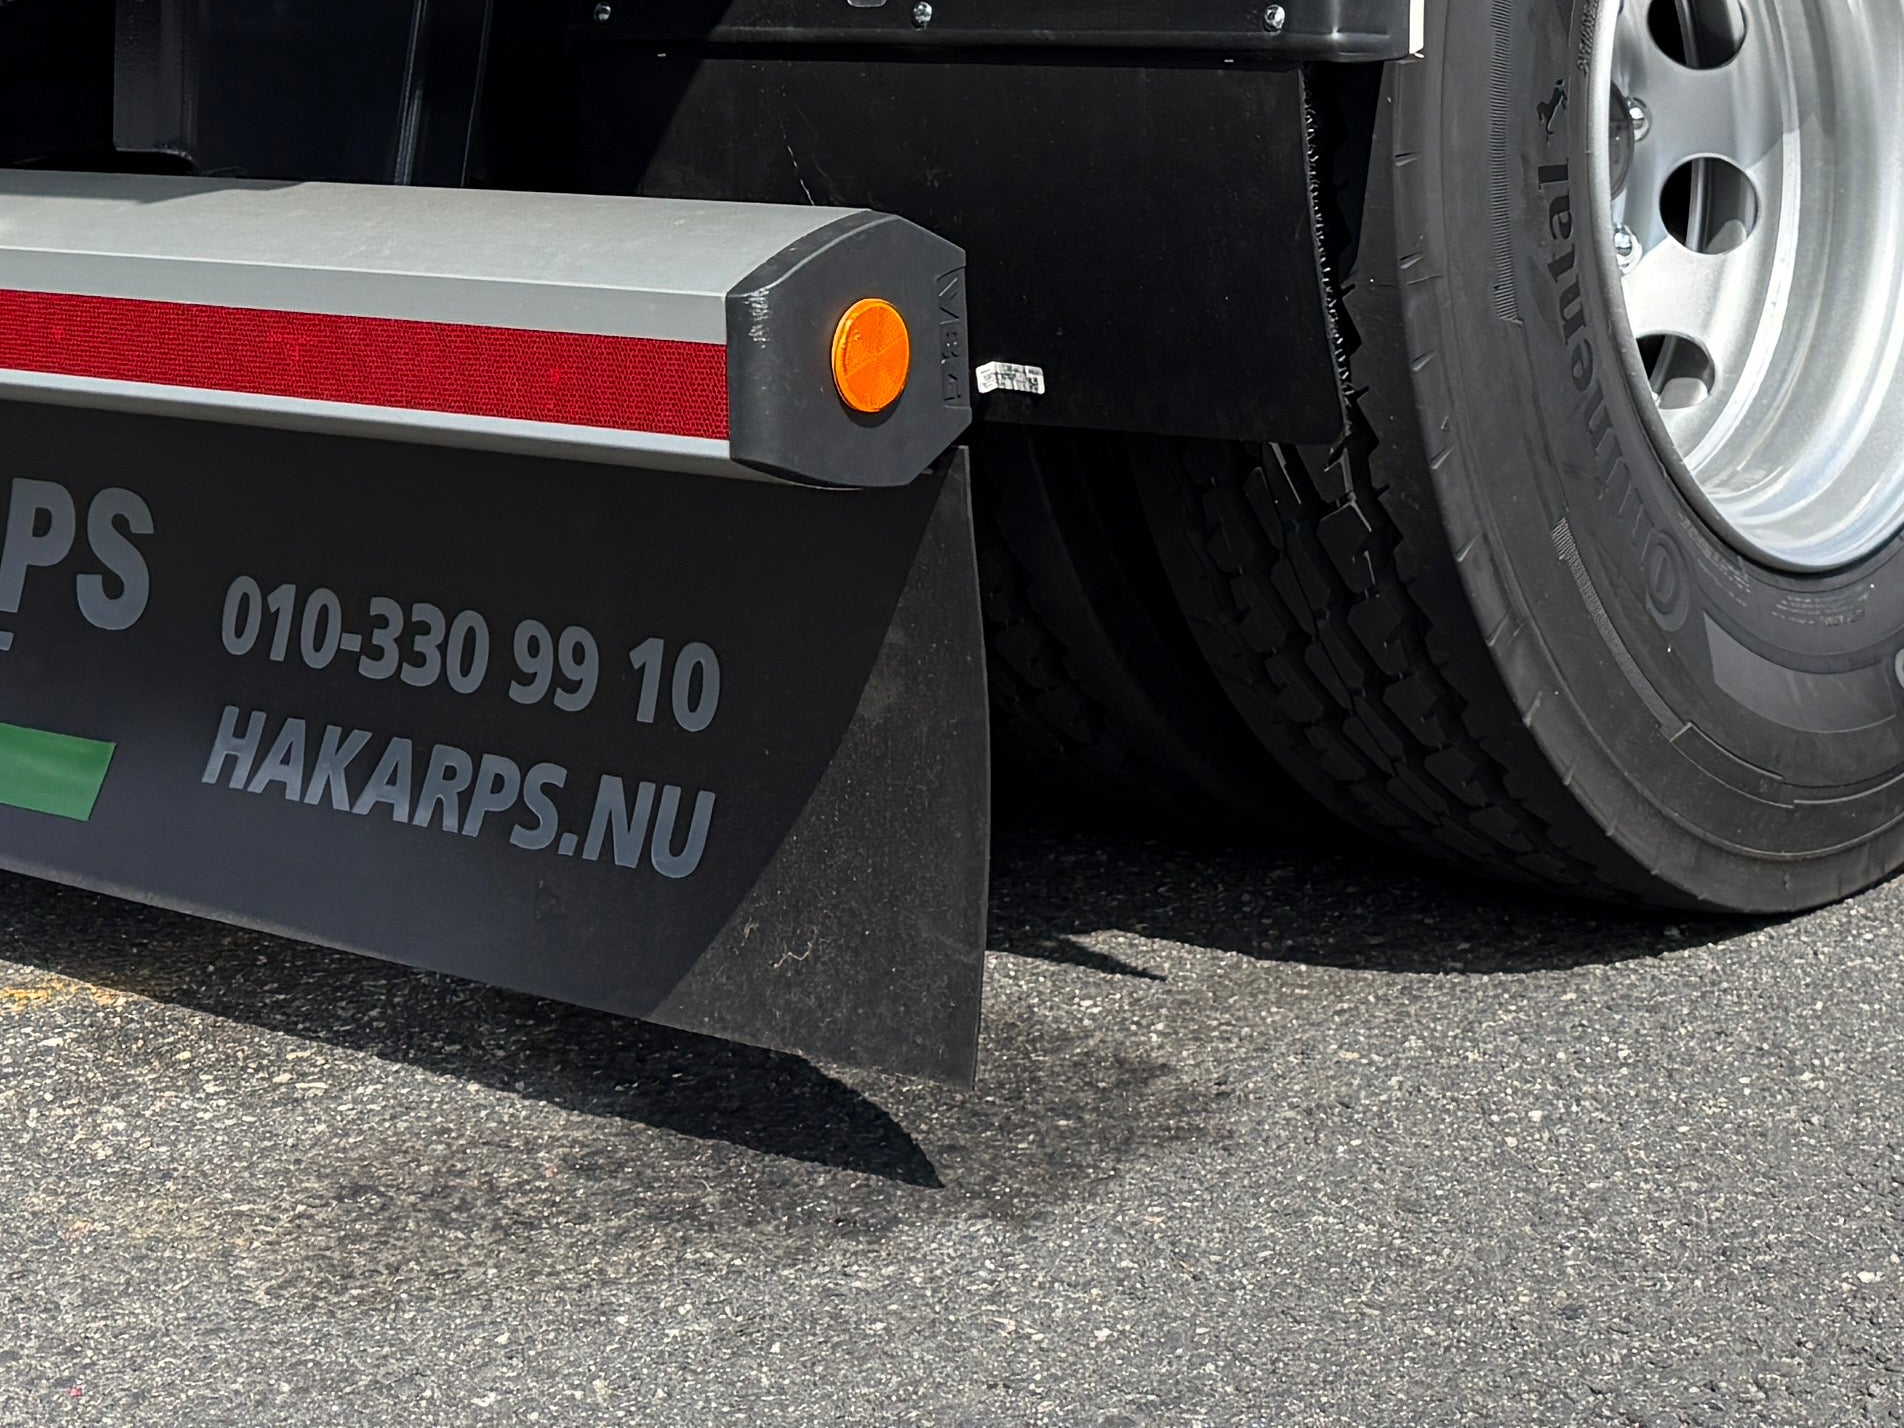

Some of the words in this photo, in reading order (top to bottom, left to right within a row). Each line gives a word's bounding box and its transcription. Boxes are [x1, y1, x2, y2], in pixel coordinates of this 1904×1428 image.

[221, 574, 490, 696] 010-330
[508, 620, 599, 713] 99
[630, 638, 722, 732] 10
[202, 705, 716, 880] HAKARPS.NU
